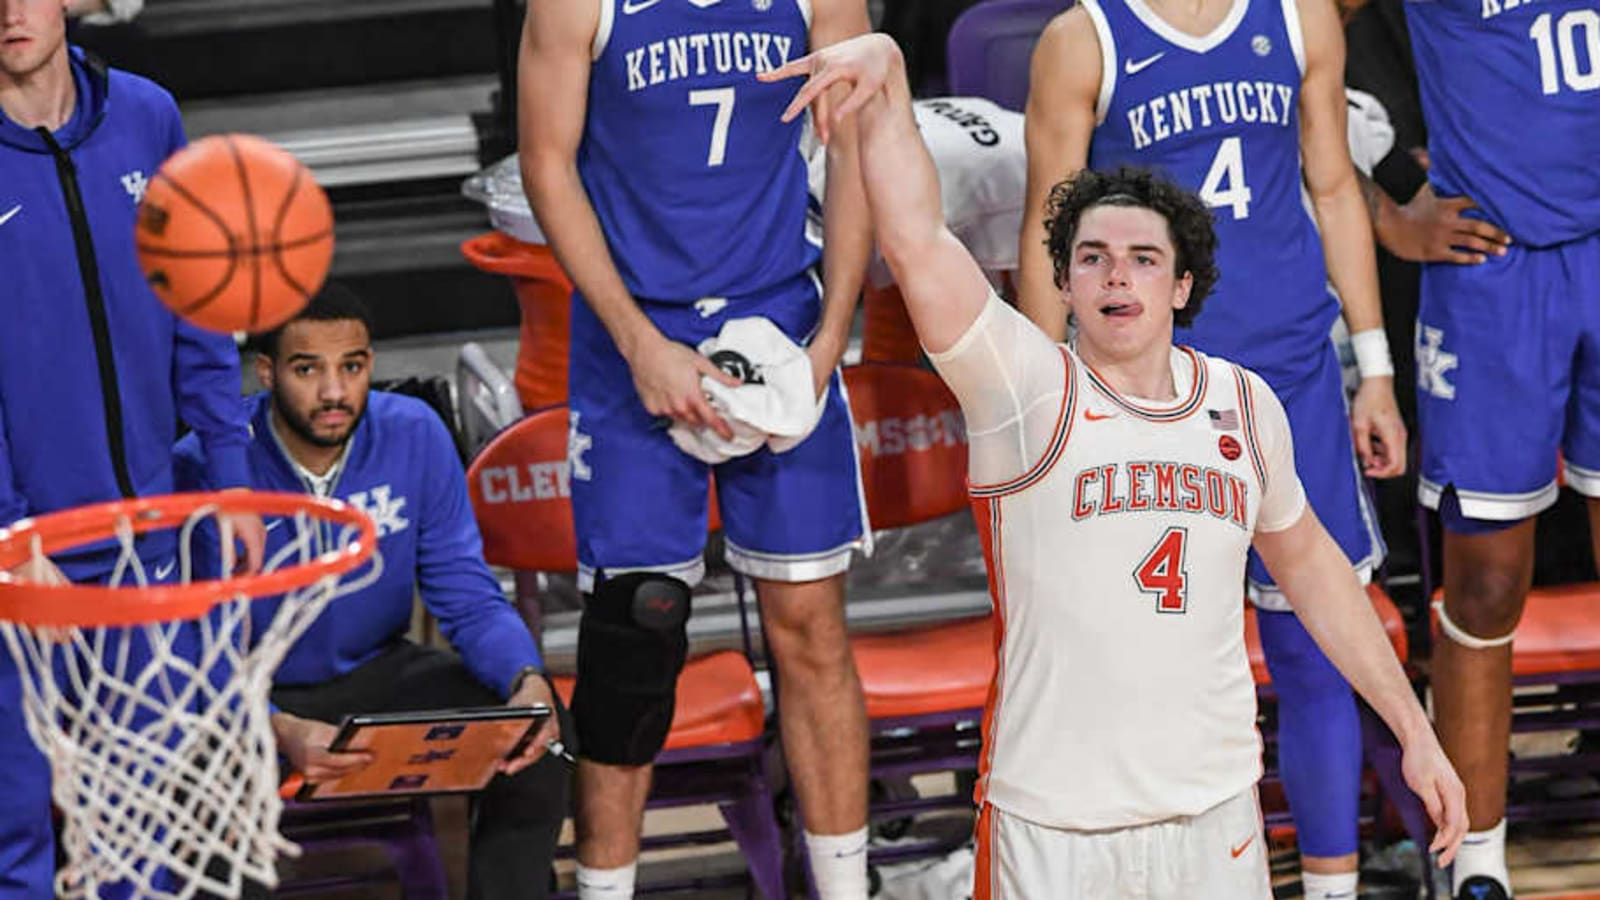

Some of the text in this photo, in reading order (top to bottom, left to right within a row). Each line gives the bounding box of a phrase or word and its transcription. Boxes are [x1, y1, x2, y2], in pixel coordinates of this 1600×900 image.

[625, 31, 791, 91] KENTUCKY
[1529, 8, 1600, 95] 10
[689, 87, 735, 167] 7
[1127, 81, 1292, 150] KENTUCKY
[1199, 137, 1251, 220] 4
[1071, 460, 1248, 531] CLEMSON
[1132, 527, 1188, 614] 4
